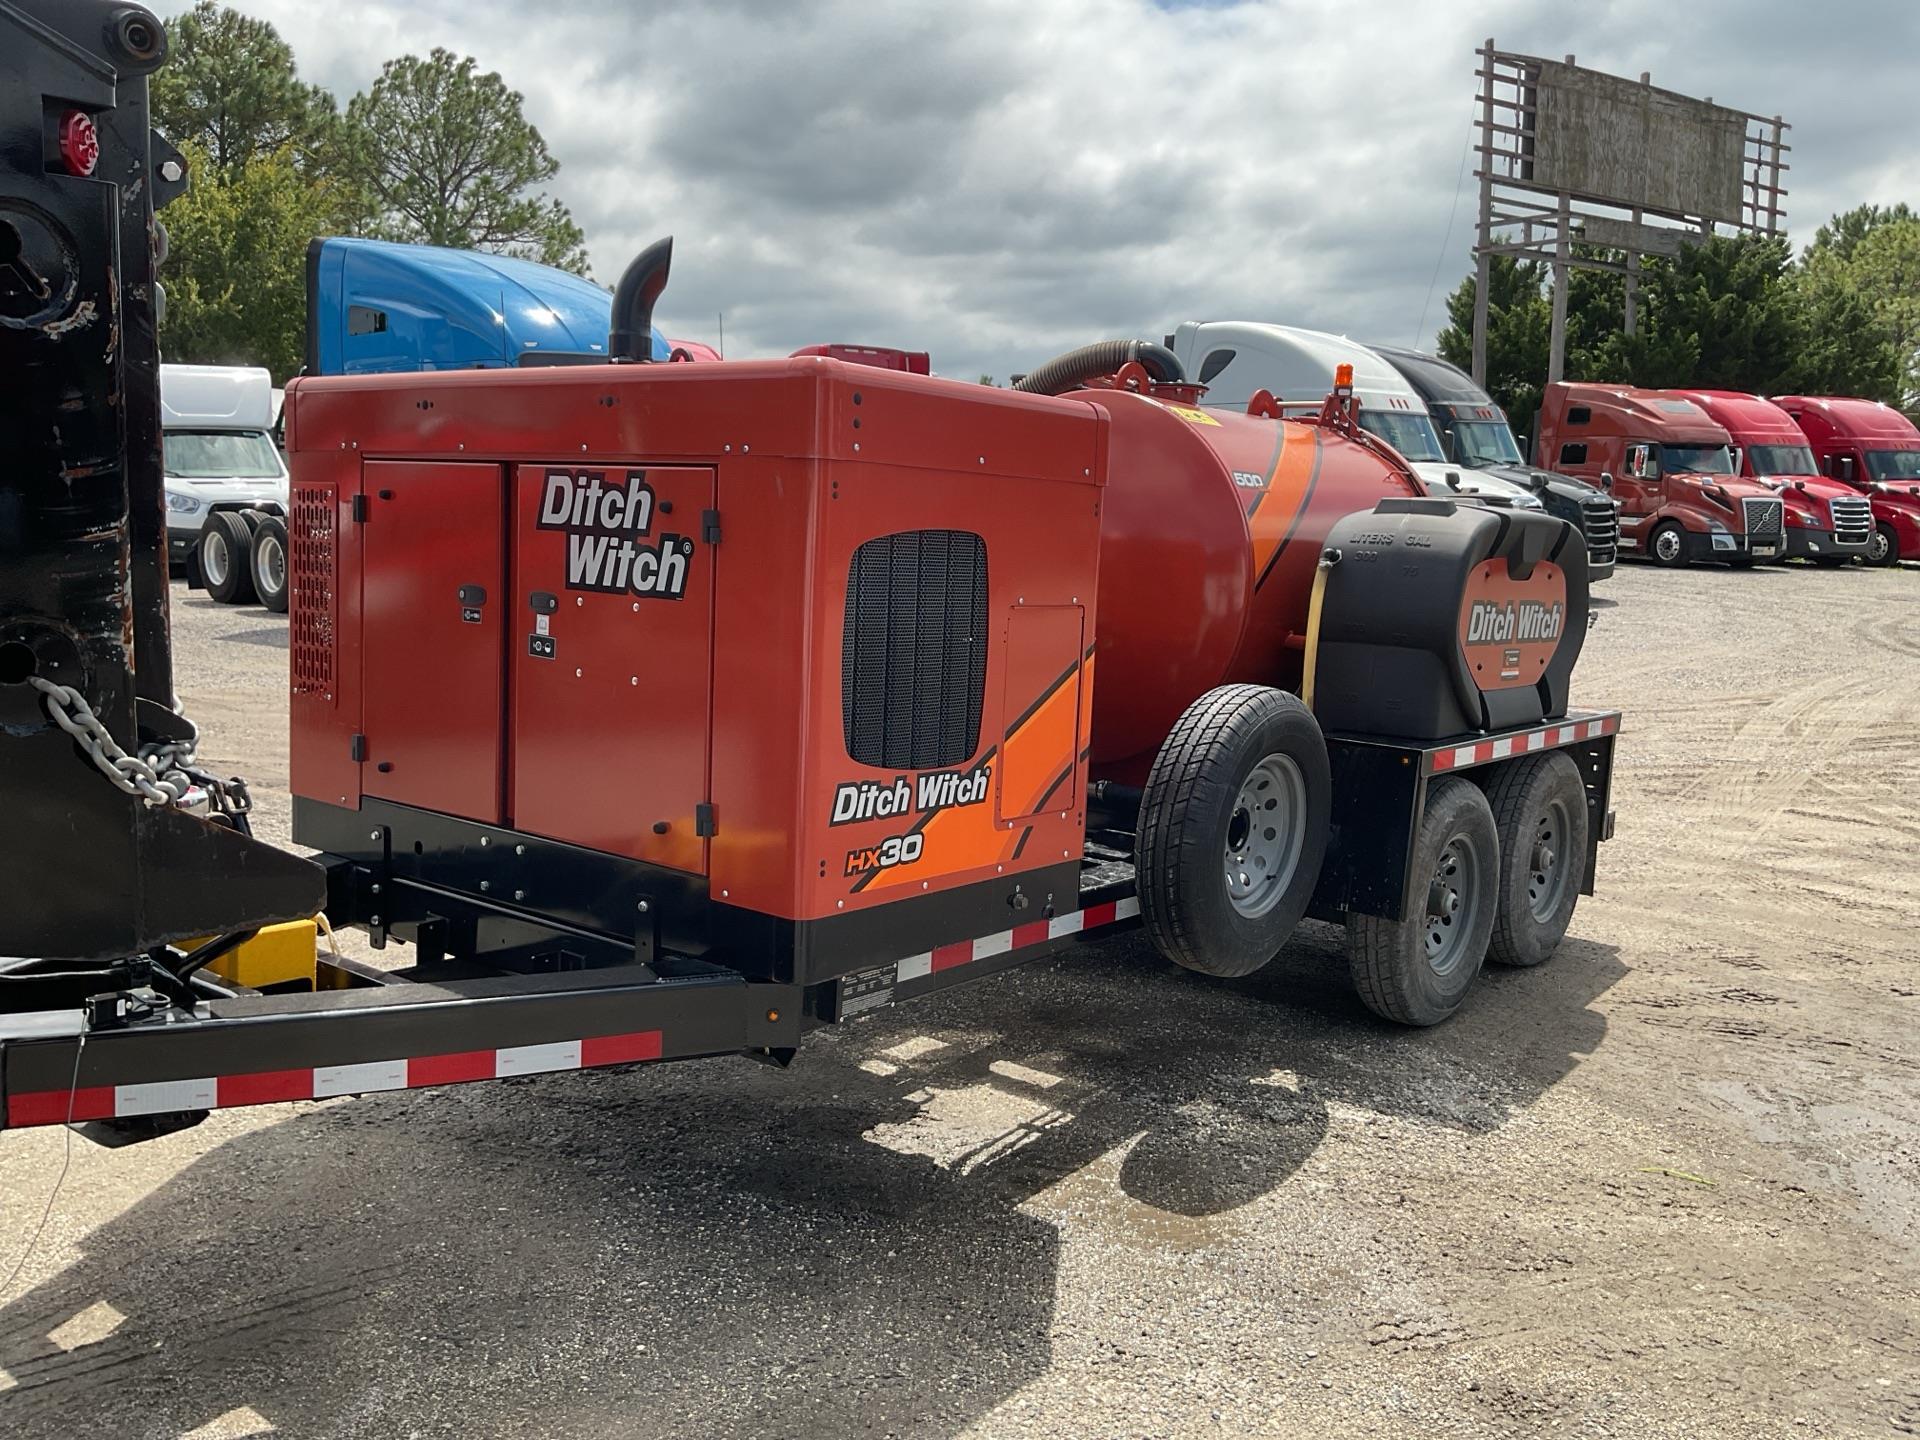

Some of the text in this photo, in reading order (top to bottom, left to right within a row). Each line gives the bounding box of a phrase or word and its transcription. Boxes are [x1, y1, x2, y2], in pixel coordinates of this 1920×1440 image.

[1233, 471, 1264, 488] 500
[541, 475, 652, 530] Ditch
[1349, 532, 1395, 546] LITERS
[1468, 604, 1561, 641] Ditch Witch
[833, 779, 910, 822] Ditch
[847, 833, 923, 873] HX30
